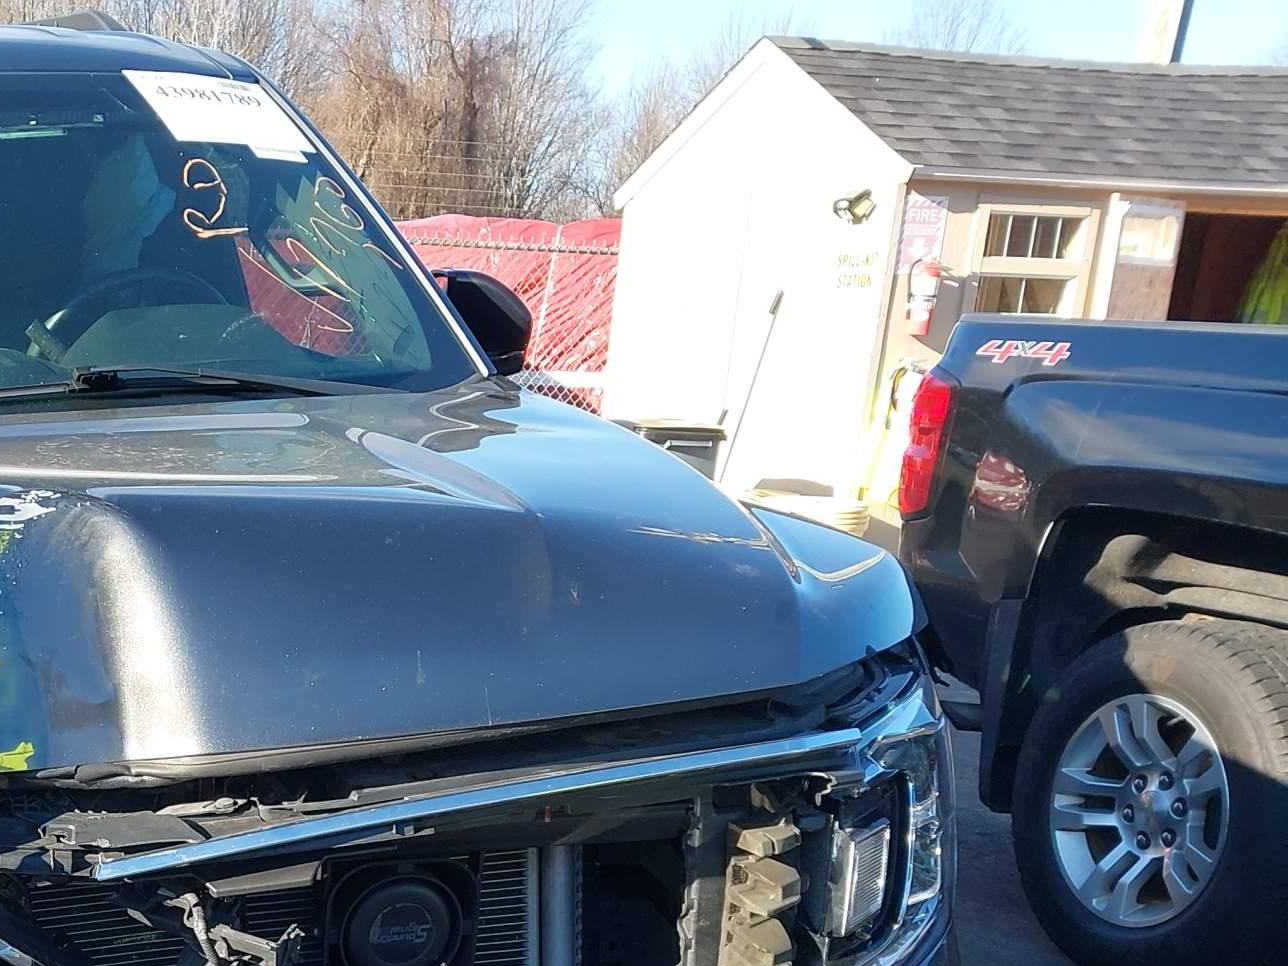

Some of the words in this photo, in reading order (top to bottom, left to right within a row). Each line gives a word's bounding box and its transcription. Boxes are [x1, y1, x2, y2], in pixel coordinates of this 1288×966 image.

[155, 85, 262, 107] 43981789
[908, 208, 938, 222] FIRE
[975, 339, 1072, 366] 4x4
